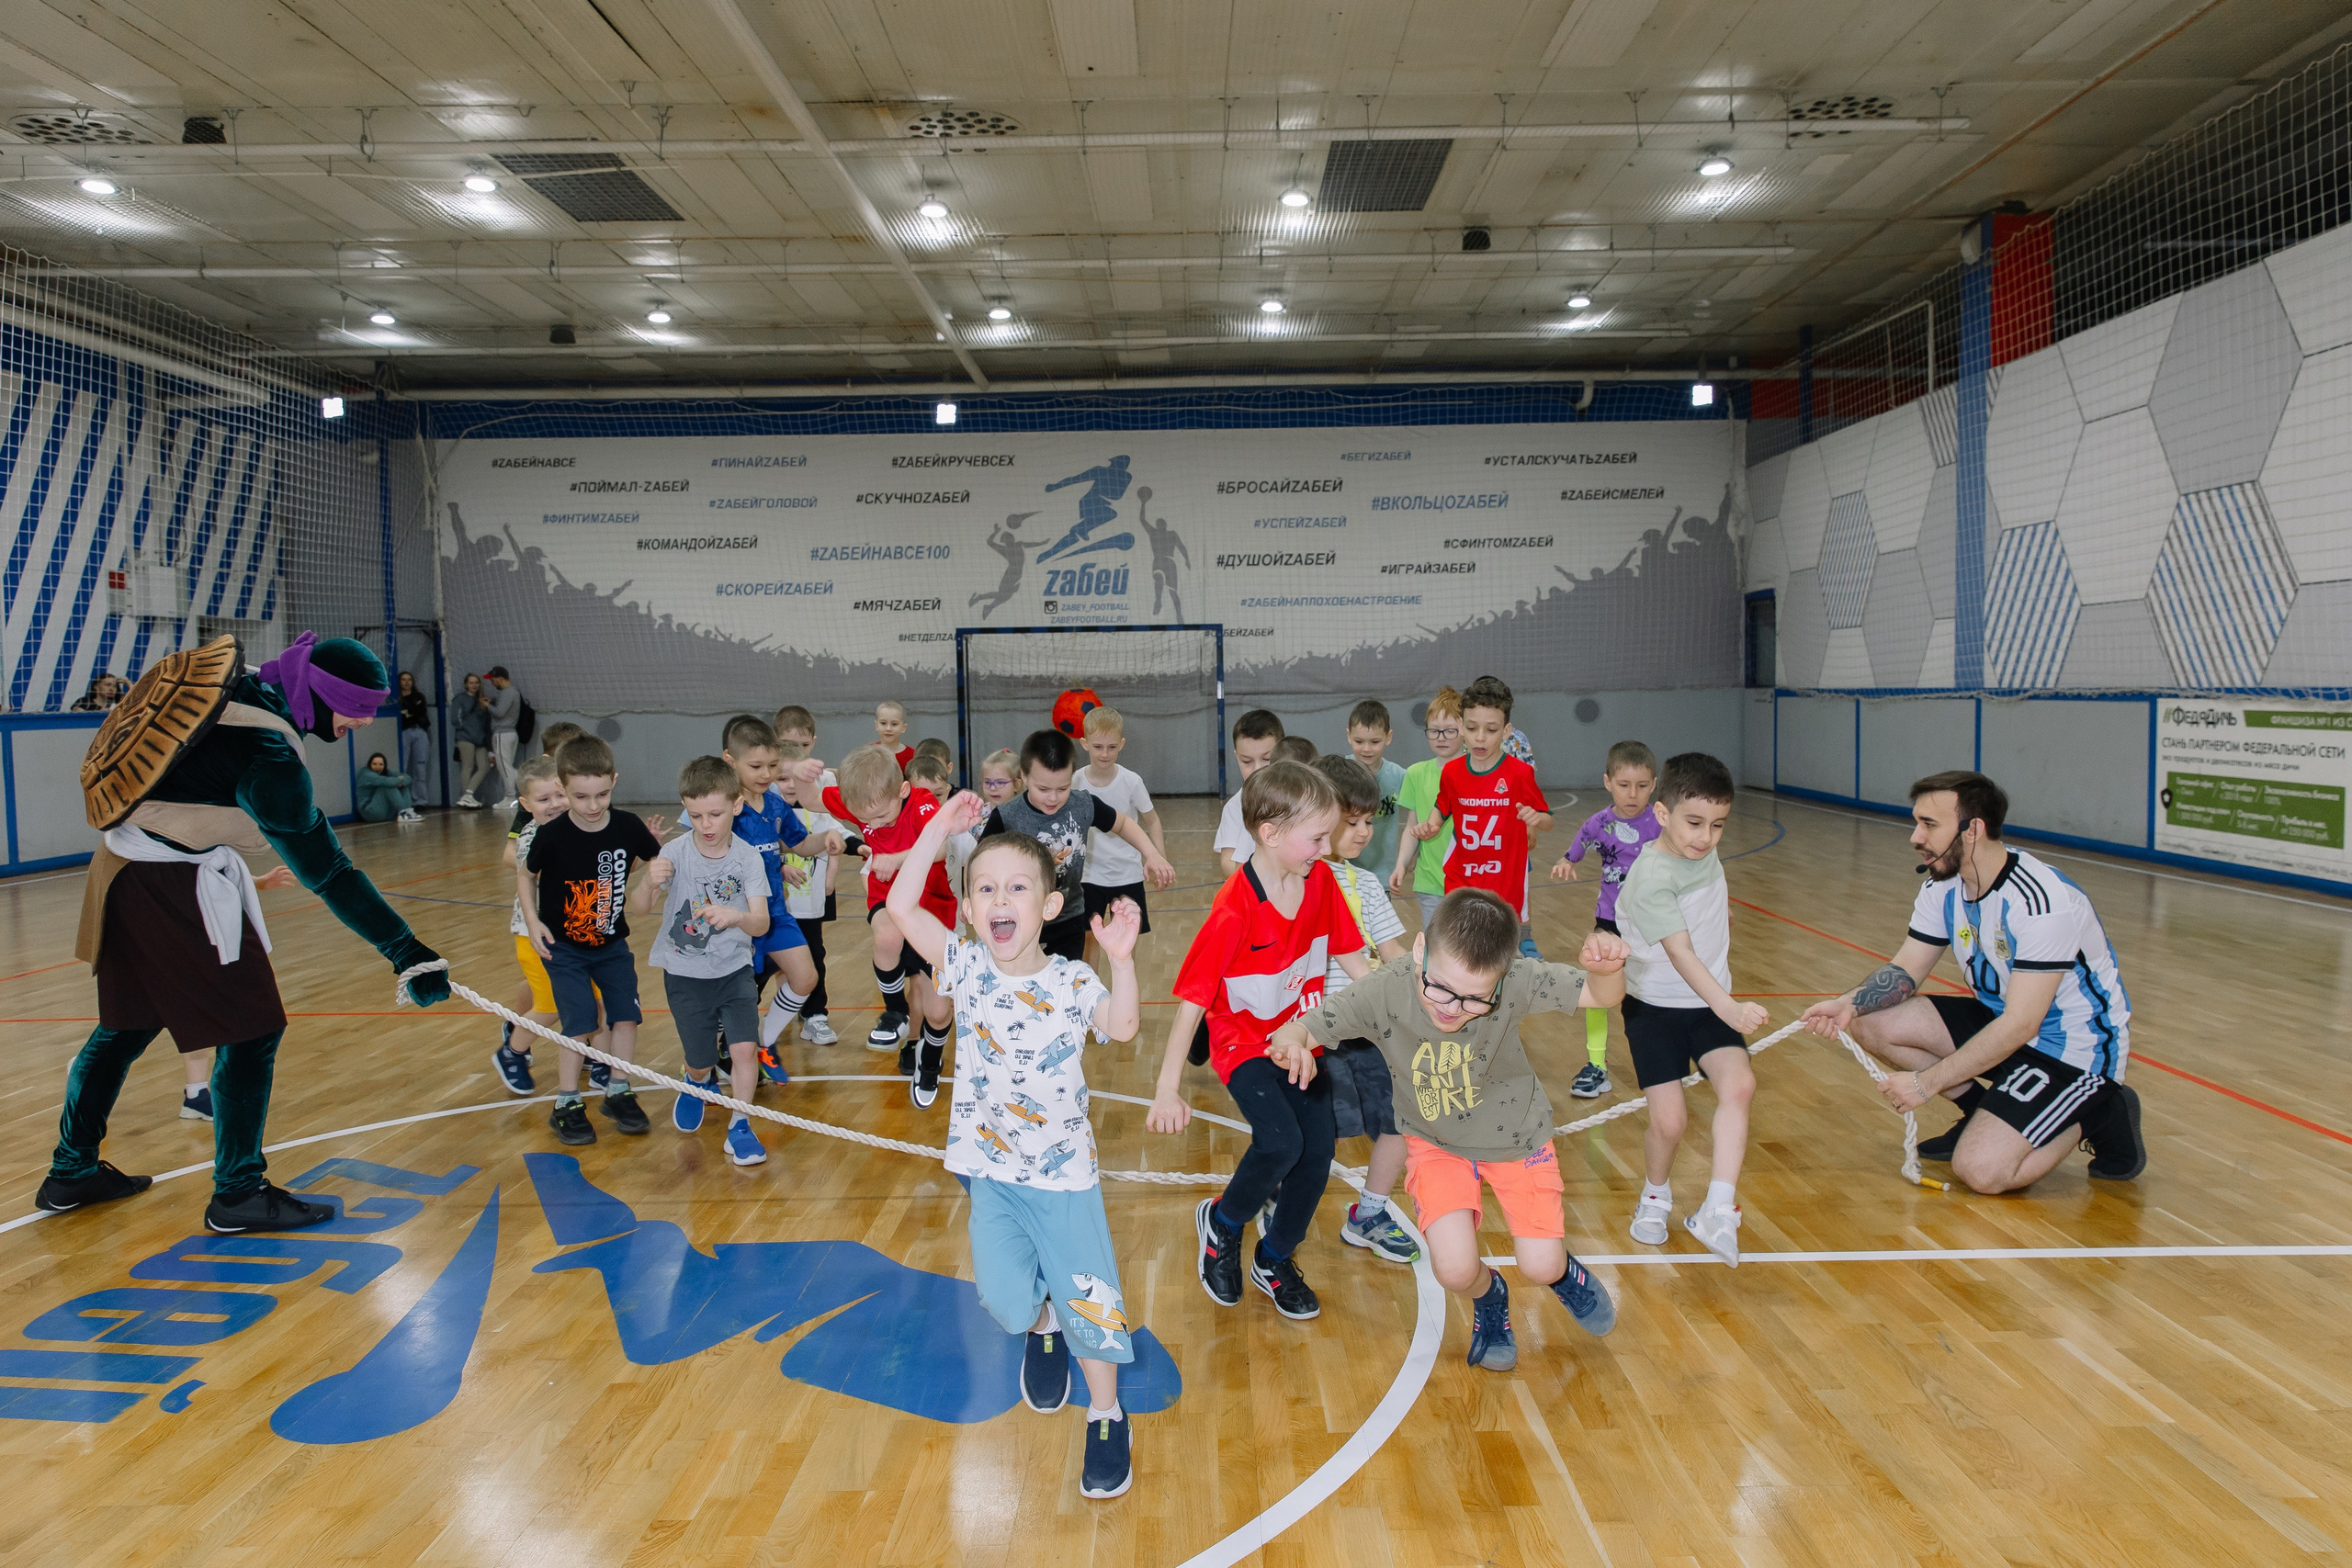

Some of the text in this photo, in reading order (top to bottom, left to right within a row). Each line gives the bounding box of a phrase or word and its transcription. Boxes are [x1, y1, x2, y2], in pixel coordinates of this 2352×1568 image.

[492, 456, 576, 468] #ZАБЕЙНАВСЕ
[711, 455, 807, 468] #ПИНАЙZАБЕЙ
[891, 454, 1016, 468] #ZАБЕЙКРУЧЕВСЕХ
[1340, 450, 1411, 461] #БЕГИZАБЕЙ
[1484, 452, 1637, 467] #УСТАЛСКУЧАТЬZАБЕЙ
[570, 479, 690, 493] #ПОЙМАЛ-ZАБЕЙ
[1216, 477, 1343, 494] #БРОСАЙZАБЕЙ
[855, 490, 970, 504] #СКУЧНОZАБЕЙ
[1561, 486, 1665, 501] #ZАБЕЙСМЕЛЕЙ
[709, 496, 818, 509] #ZАБЕЙГОЛОВОЙ
[1371, 491, 1510, 513] #ВКОЛЬЦОZАБЕЙ
[542, 511, 639, 524] #ФИНТИМZАБЕЙ
[1254, 515, 1347, 529] #УСПЕЙZАБЕЙ
[637, 535, 758, 552] #КОМАНДОЙZАБЕЙ
[1443, 535, 1554, 549] #СФИНТОМZАБЕЙ
[810, 543, 950, 561] #ZАБЕЙНАВСЕ100
[1216, 549, 1336, 570] #ДУШОЙZАБЕЙ
[716, 579, 833, 596] #СКОРЕЙZАБЕЙ
[853, 597, 942, 612] #МЯЧZАБЕЙ
[1205, 626, 1274, 637] #ОБЕЙZАБЕЙ
[1461, 814, 1502, 851] 54
[1966, 955, 2000, 996] 10
[1997, 1064, 2050, 1102] 10
[1069, 1317, 1085, 1328] IT'S
[1084, 1329, 1094, 1338] TO
